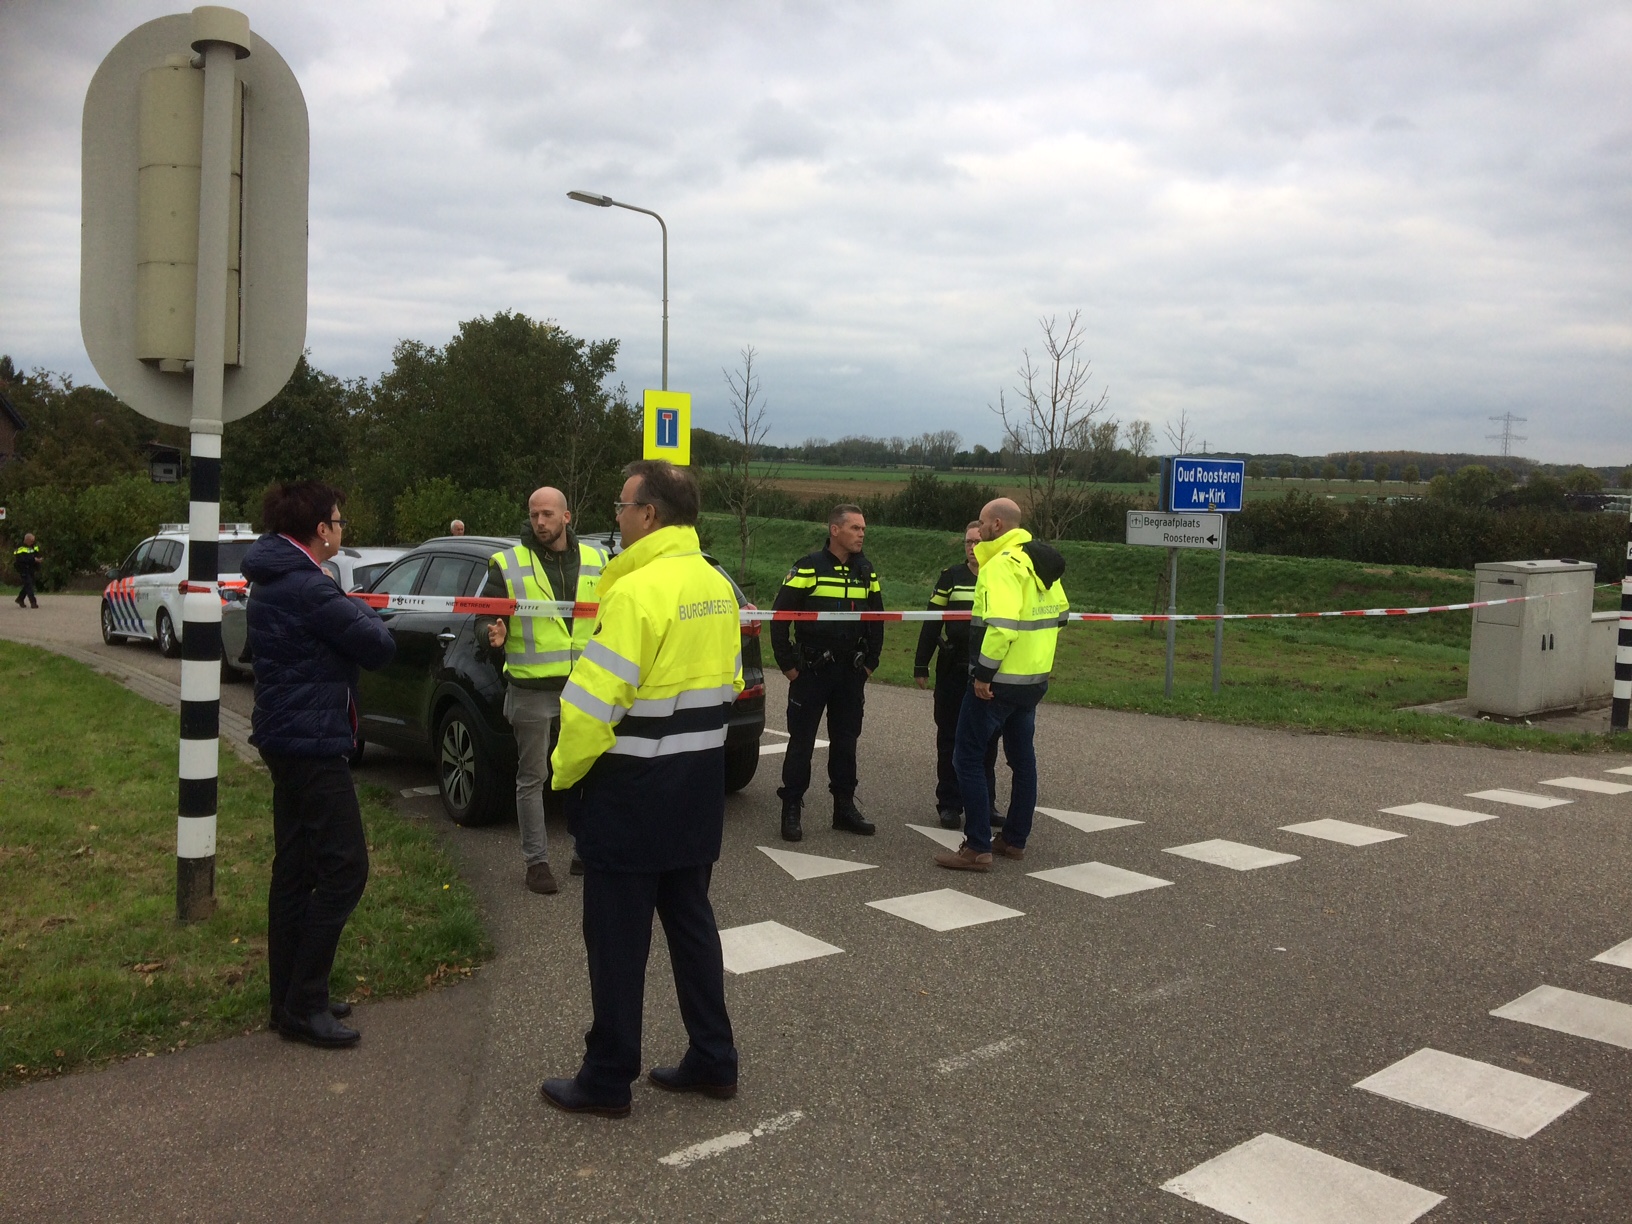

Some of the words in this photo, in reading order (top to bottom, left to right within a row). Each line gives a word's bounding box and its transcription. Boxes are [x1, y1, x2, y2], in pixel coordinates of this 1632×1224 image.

[1177, 466, 1195, 482] Oud
[1197, 467, 1240, 484] Roosteren
[1191, 488, 1226, 503] Aw-Kirk
[1144, 517, 1200, 529] Begraafplaats
[1163, 533, 1204, 544] Roosteren
[679, 599, 733, 621] BURGEMEESTE
